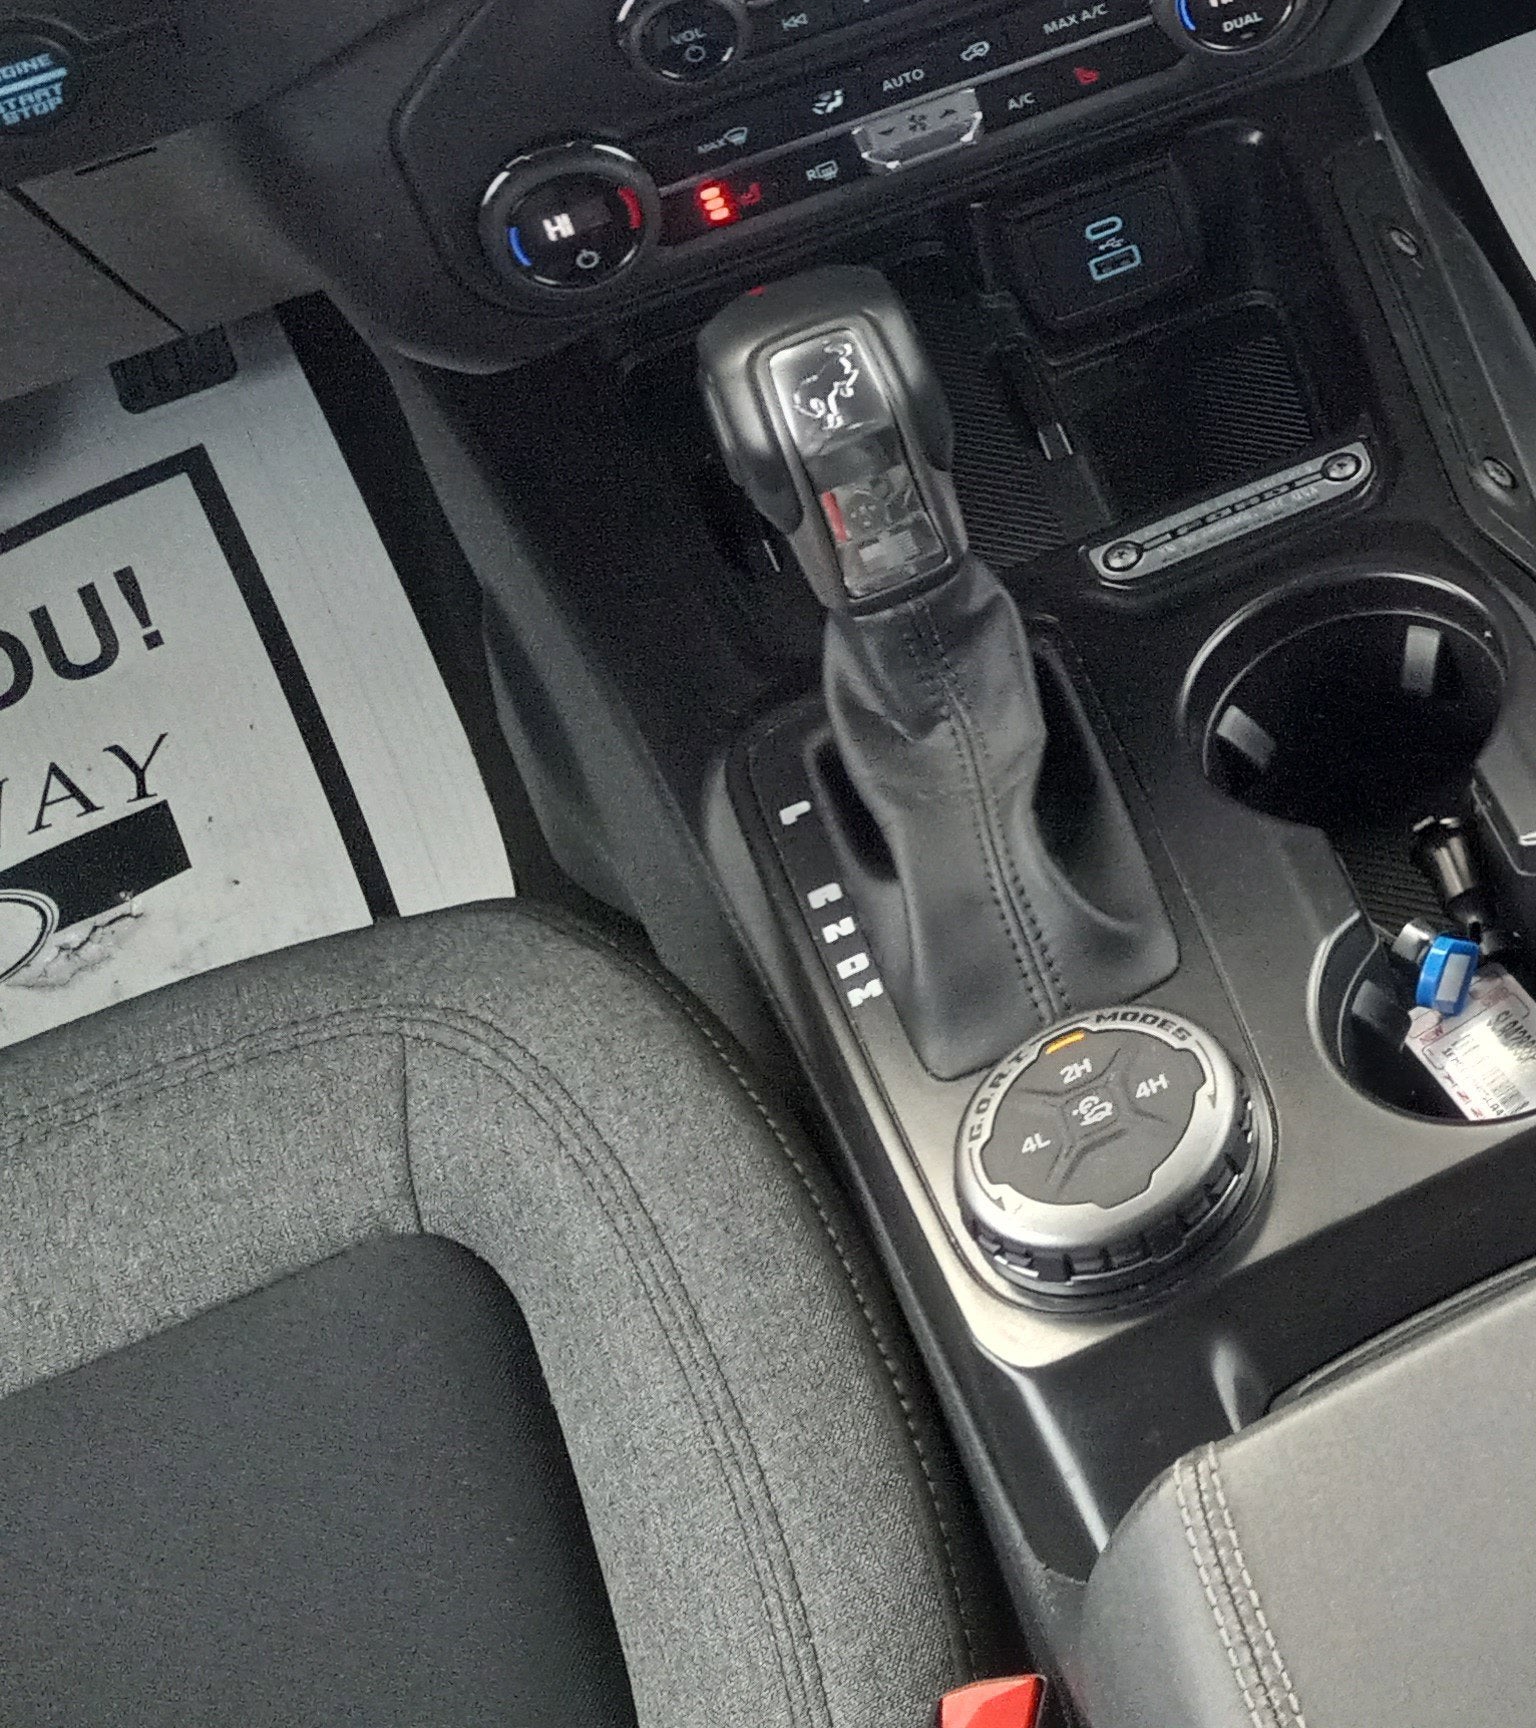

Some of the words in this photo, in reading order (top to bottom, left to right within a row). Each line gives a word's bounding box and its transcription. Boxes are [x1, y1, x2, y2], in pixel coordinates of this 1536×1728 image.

[1043, 14, 1080, 36] MAX
[1080, 3, 1109, 23] A/C
[1222, 11, 1263, 33] DUAL
[671, 28, 707, 46] VOL
[882, 68, 925, 92] AUTO
[0, 81, 63, 112] TART
[1007, 92, 1036, 111] A/C
[2, 95, 63, 126] STOP
[542, 213, 575, 242] HI
[0, 733, 168, 835] AY
[779, 800, 811, 825] P
[807, 883, 843, 909] R
[822, 916, 856, 943] N
[836, 952, 870, 979] D
[847, 978, 883, 1008] M
[1095, 1012, 1192, 1042] MODES
[1060, 1058, 1093, 1085] 2H
[1135, 1073, 1170, 1099] 4H
[1021, 1132, 1052, 1154] 4L
